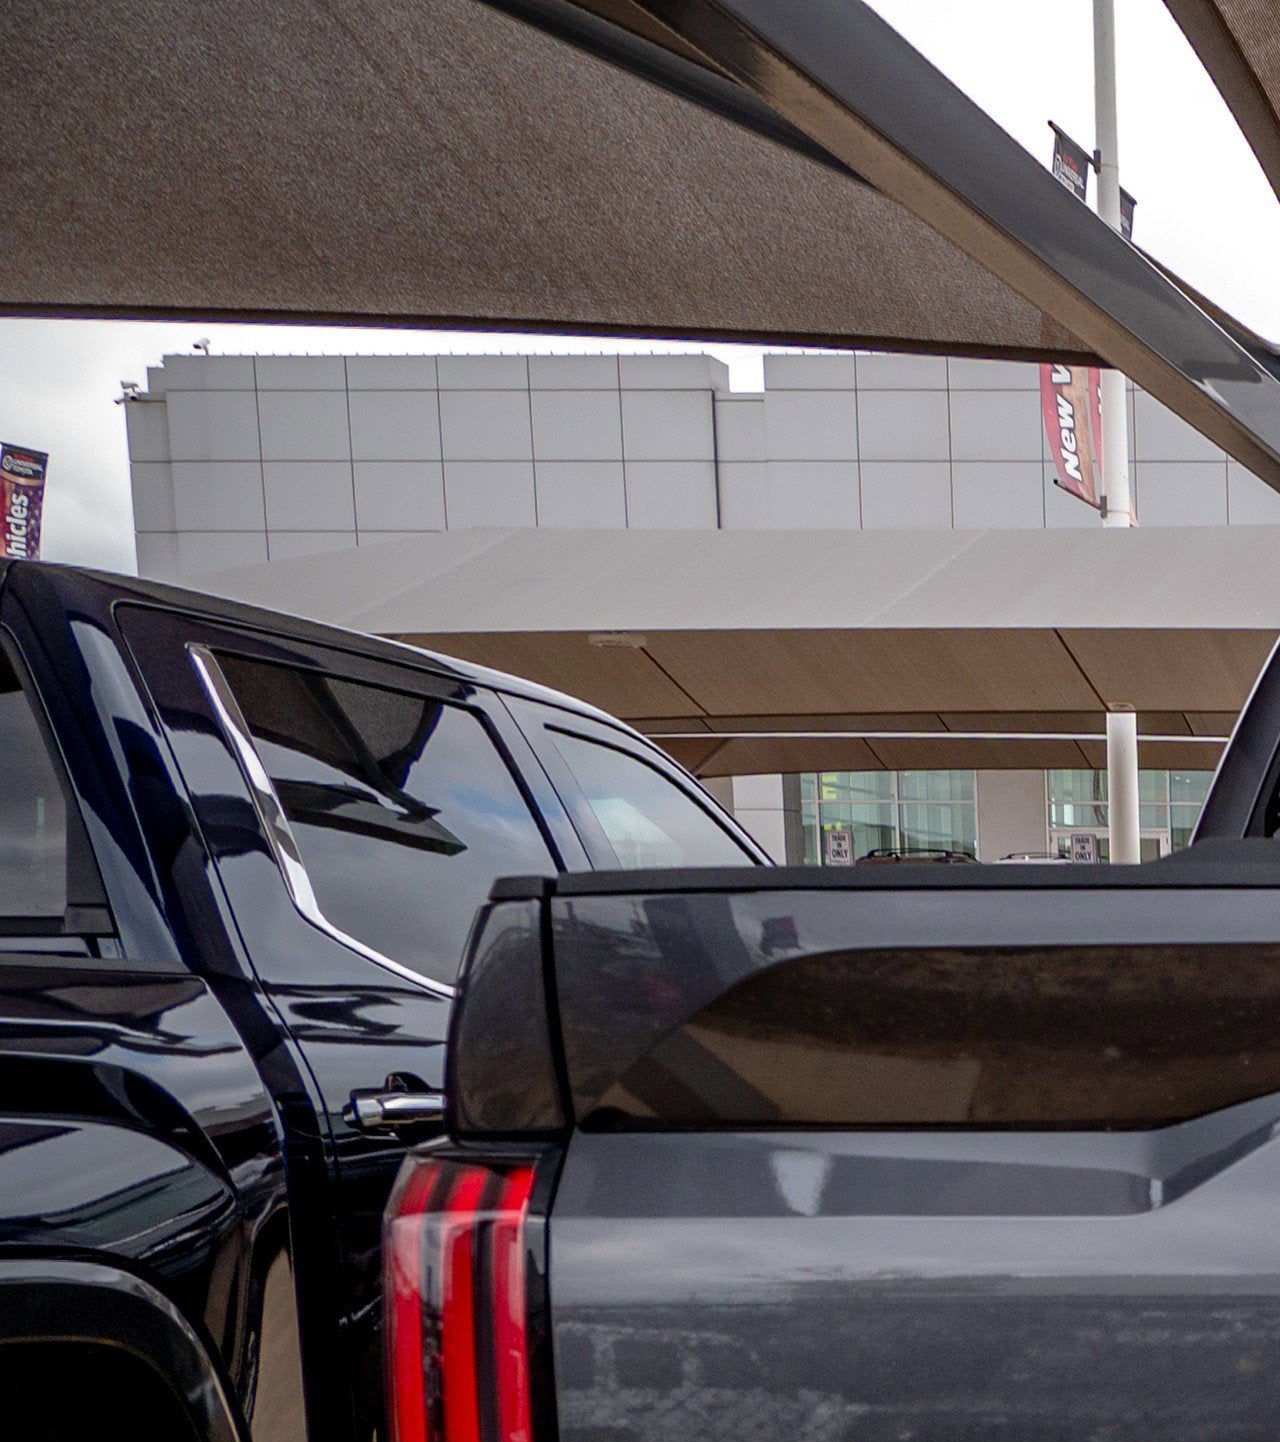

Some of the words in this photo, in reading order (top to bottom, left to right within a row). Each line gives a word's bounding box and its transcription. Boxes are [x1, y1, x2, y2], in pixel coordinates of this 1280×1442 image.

[1056, 392, 1083, 482] New
[6, 493, 29, 559] hicles
[831, 849, 848, 858] ONLY
[1075, 851, 1091, 861] ONLY
